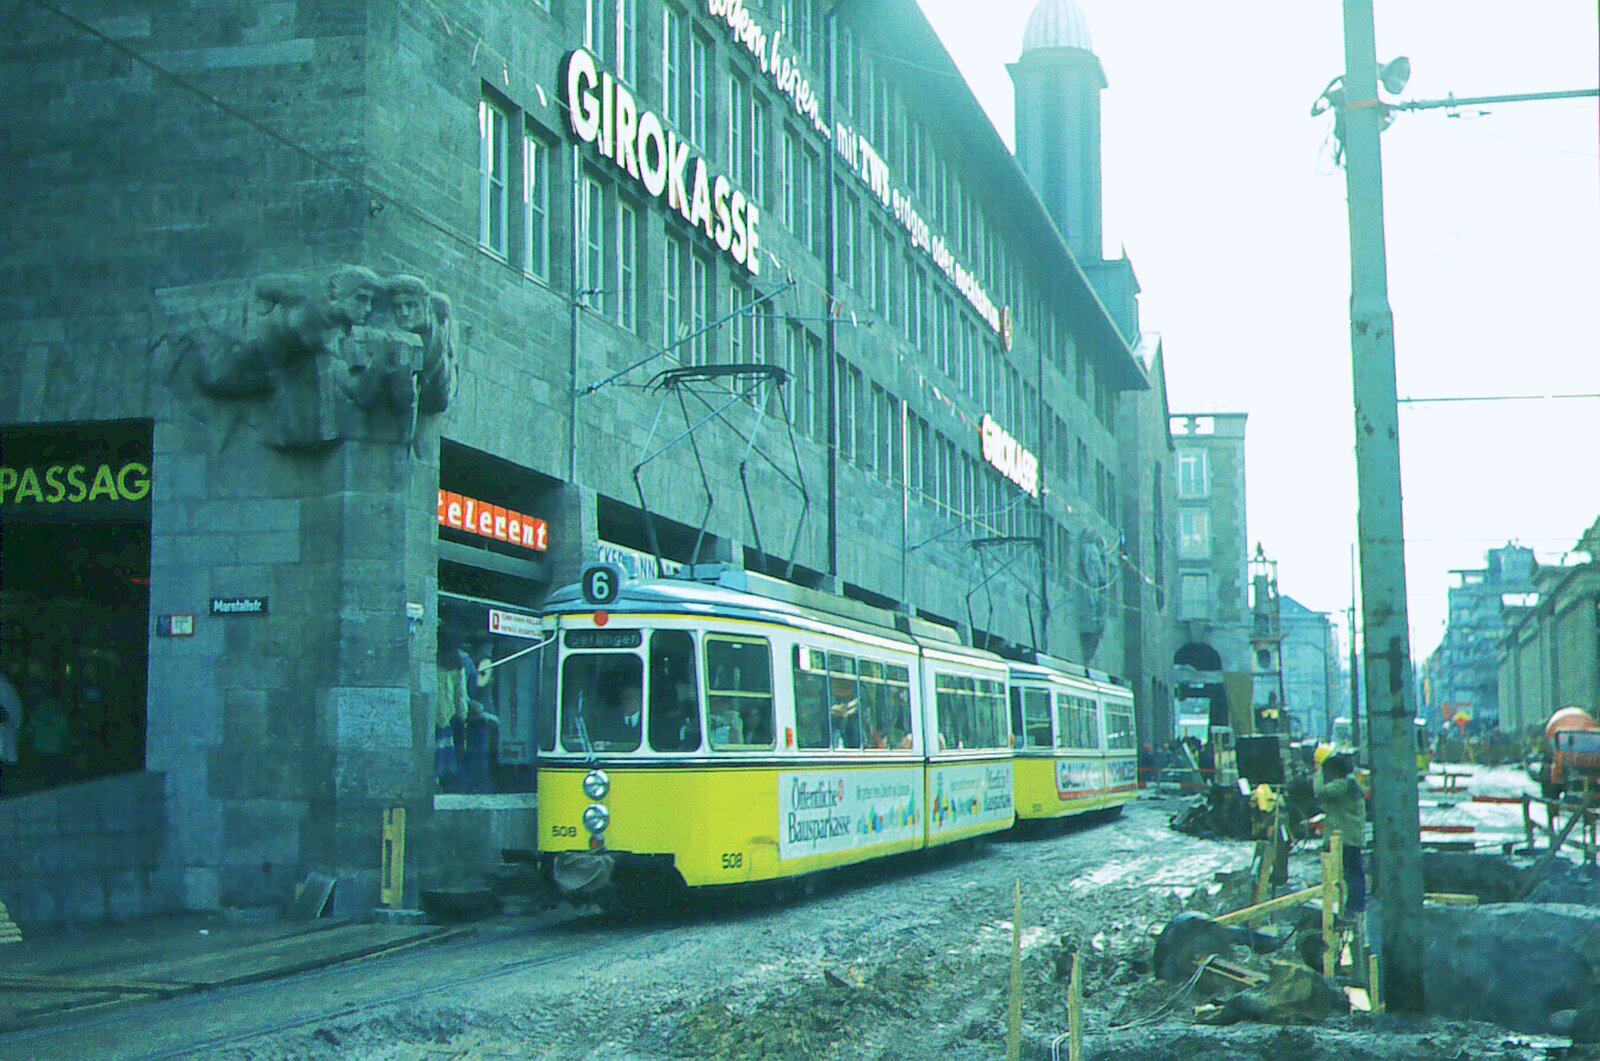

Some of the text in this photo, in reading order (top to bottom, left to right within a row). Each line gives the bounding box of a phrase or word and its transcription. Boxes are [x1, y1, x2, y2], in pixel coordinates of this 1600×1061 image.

[566, 48, 762, 276] GIROKASSE
[837, 121, 859, 171] mit
[859, 135, 890, 207] TWS
[892, 187, 931, 254] erdgas
[932, 235, 955, 282] oder
[0, 462, 150, 504] PASSAG
[592, 571, 610, 600] 6
[551, 825, 577, 838] 508
[788, 808, 851, 848] Bausparkasse
[721, 852, 743, 870] 508
